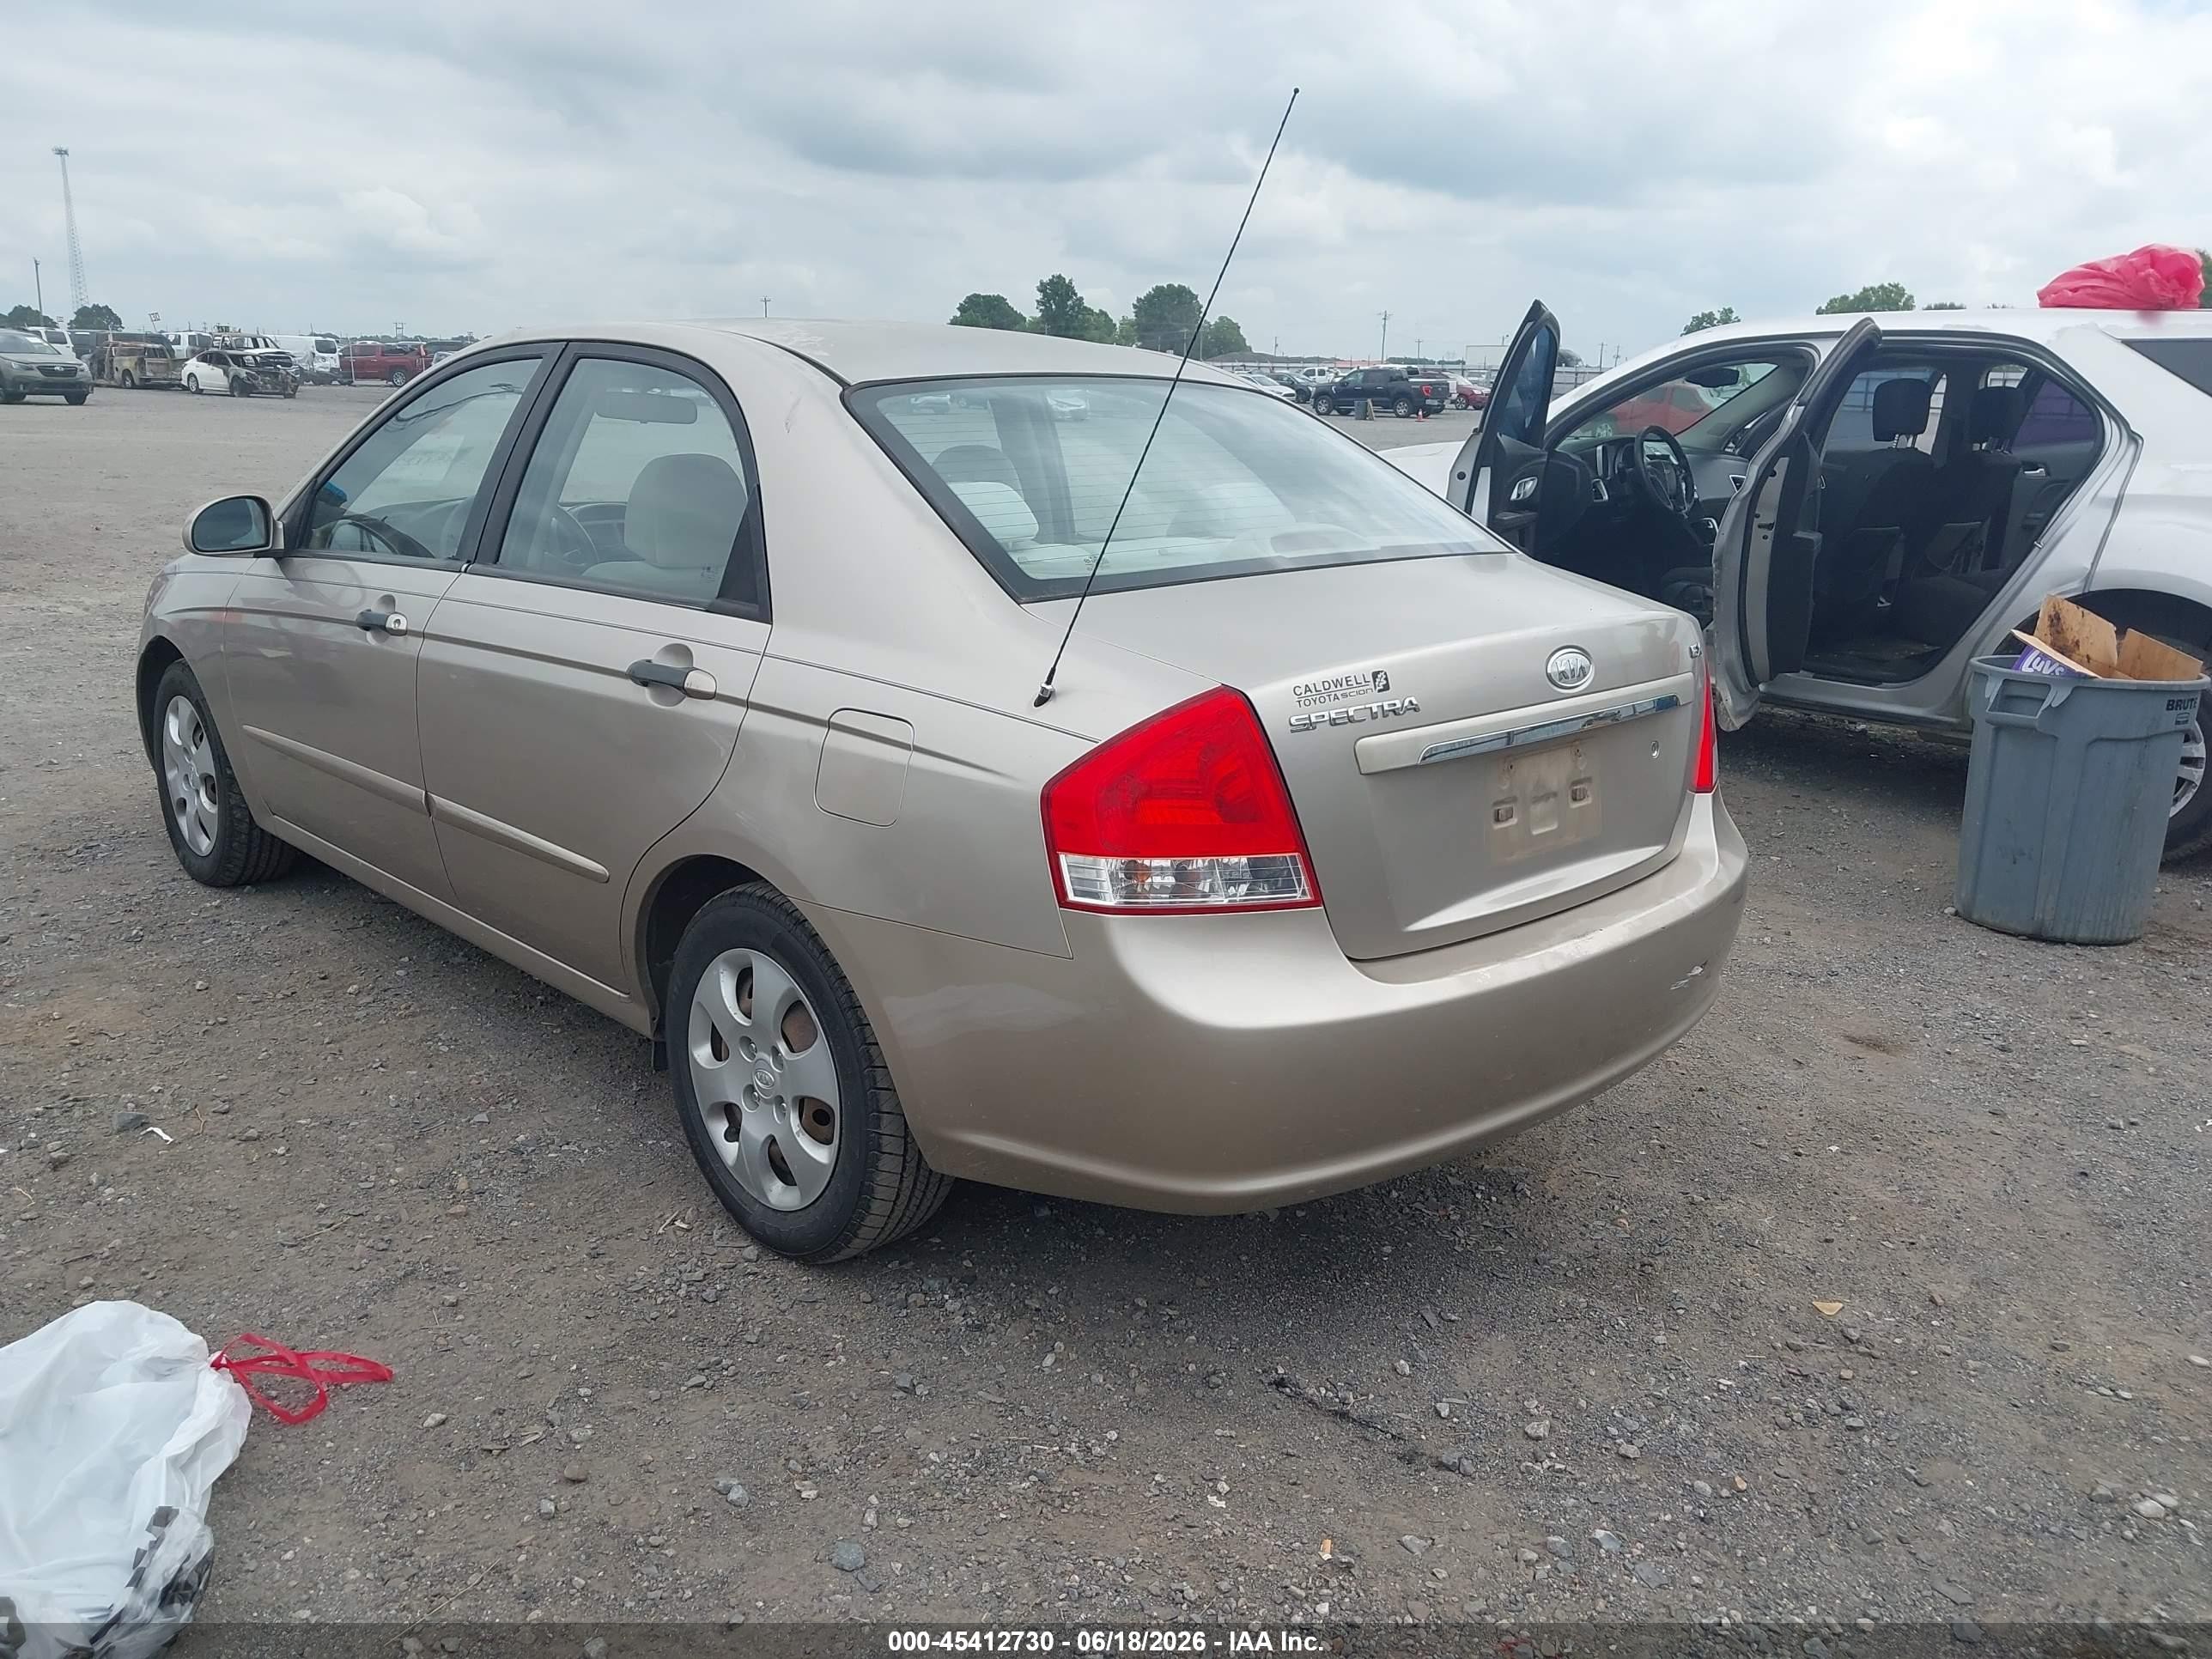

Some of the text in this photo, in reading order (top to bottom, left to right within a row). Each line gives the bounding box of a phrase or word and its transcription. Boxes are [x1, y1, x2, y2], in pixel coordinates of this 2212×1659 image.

[1556, 658, 1587, 682] KIA
[1292, 673, 1370, 696] CALDWELL
[1296, 694, 1340, 708] TOYOTA
[2166, 697, 2198, 711] BRUTE
[1289, 696, 1421, 733] SPECTRA
